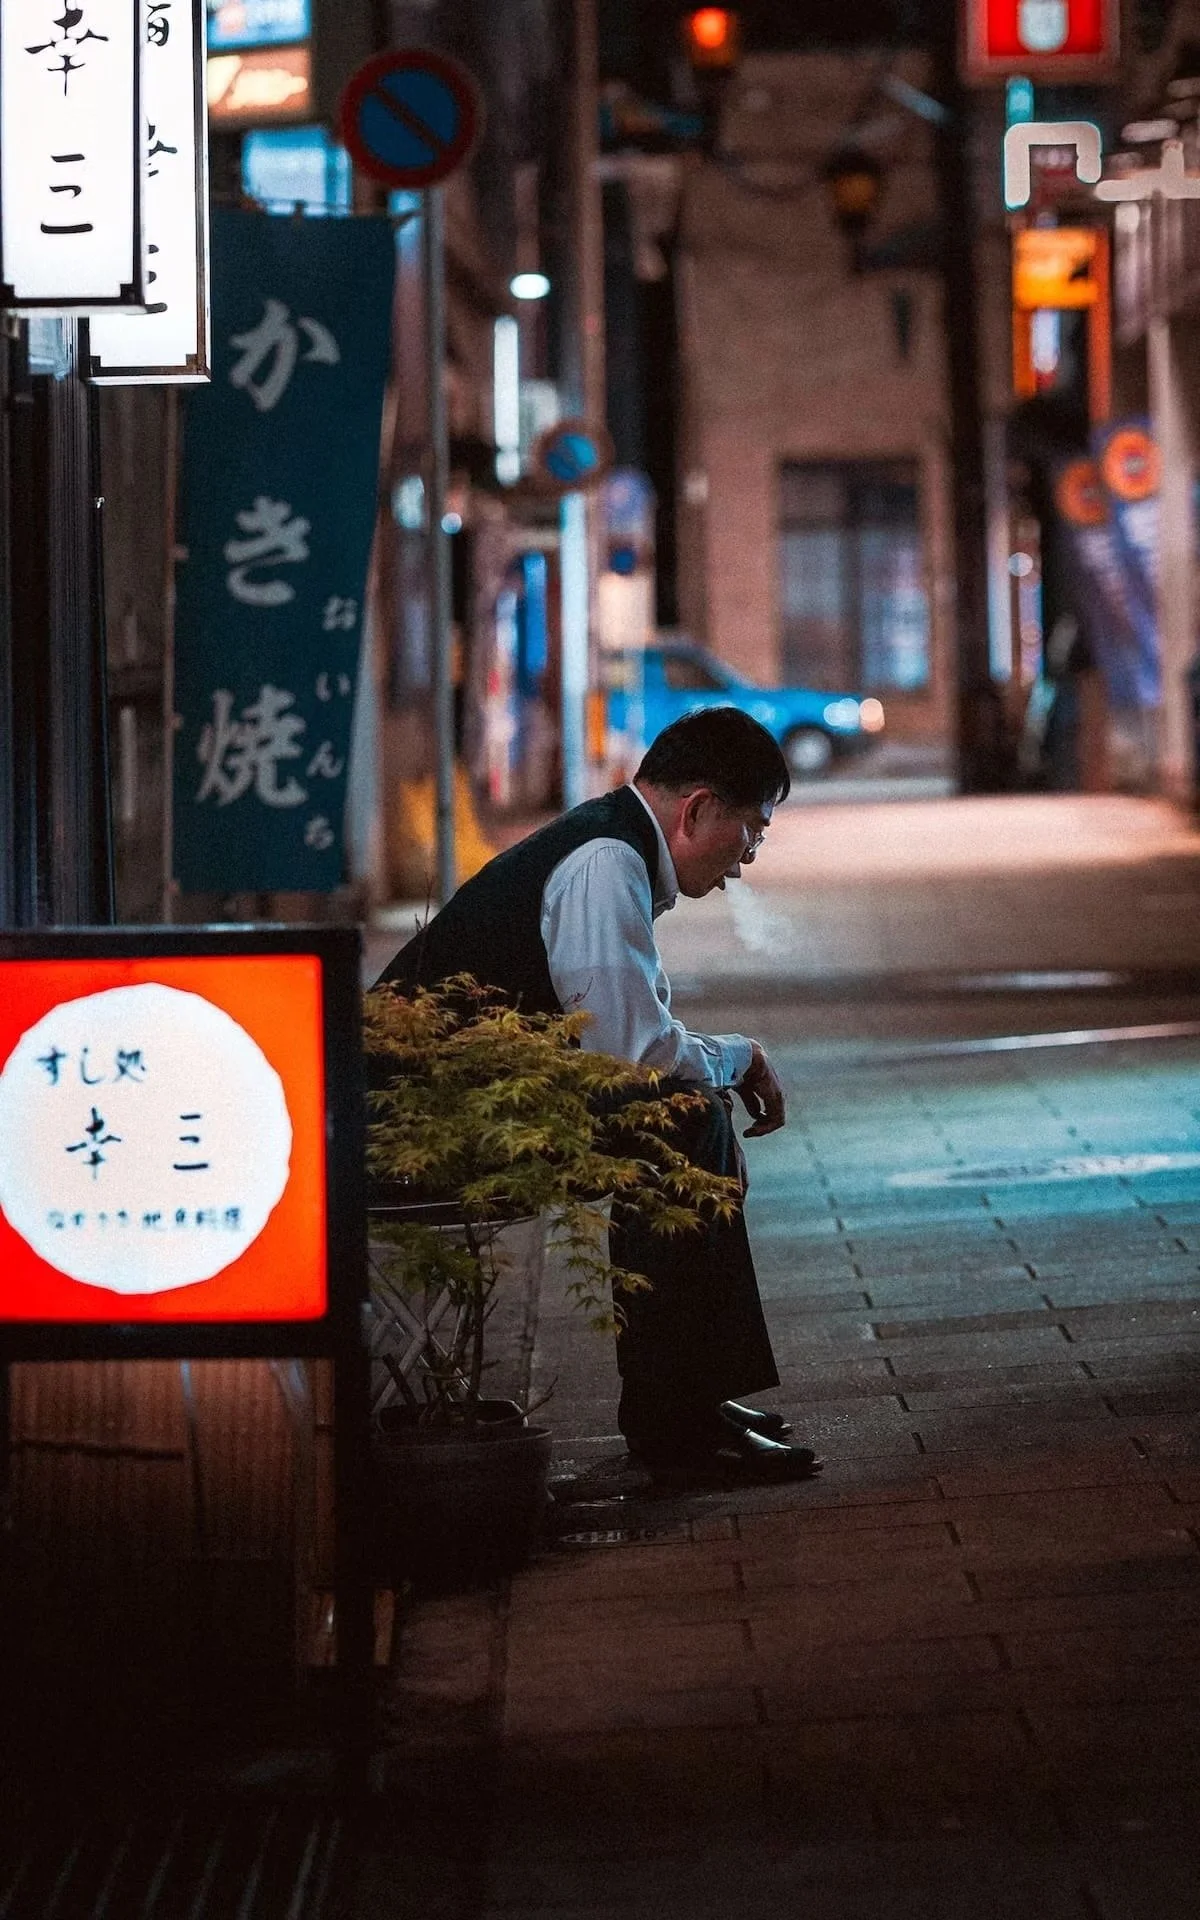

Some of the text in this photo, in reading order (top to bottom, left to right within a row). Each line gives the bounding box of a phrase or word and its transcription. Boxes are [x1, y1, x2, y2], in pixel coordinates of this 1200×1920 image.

[195, 299, 342, 808] かき焼
[36, 1045, 146, 1085] すし処
[65, 1106, 210, 1180] 幸三
